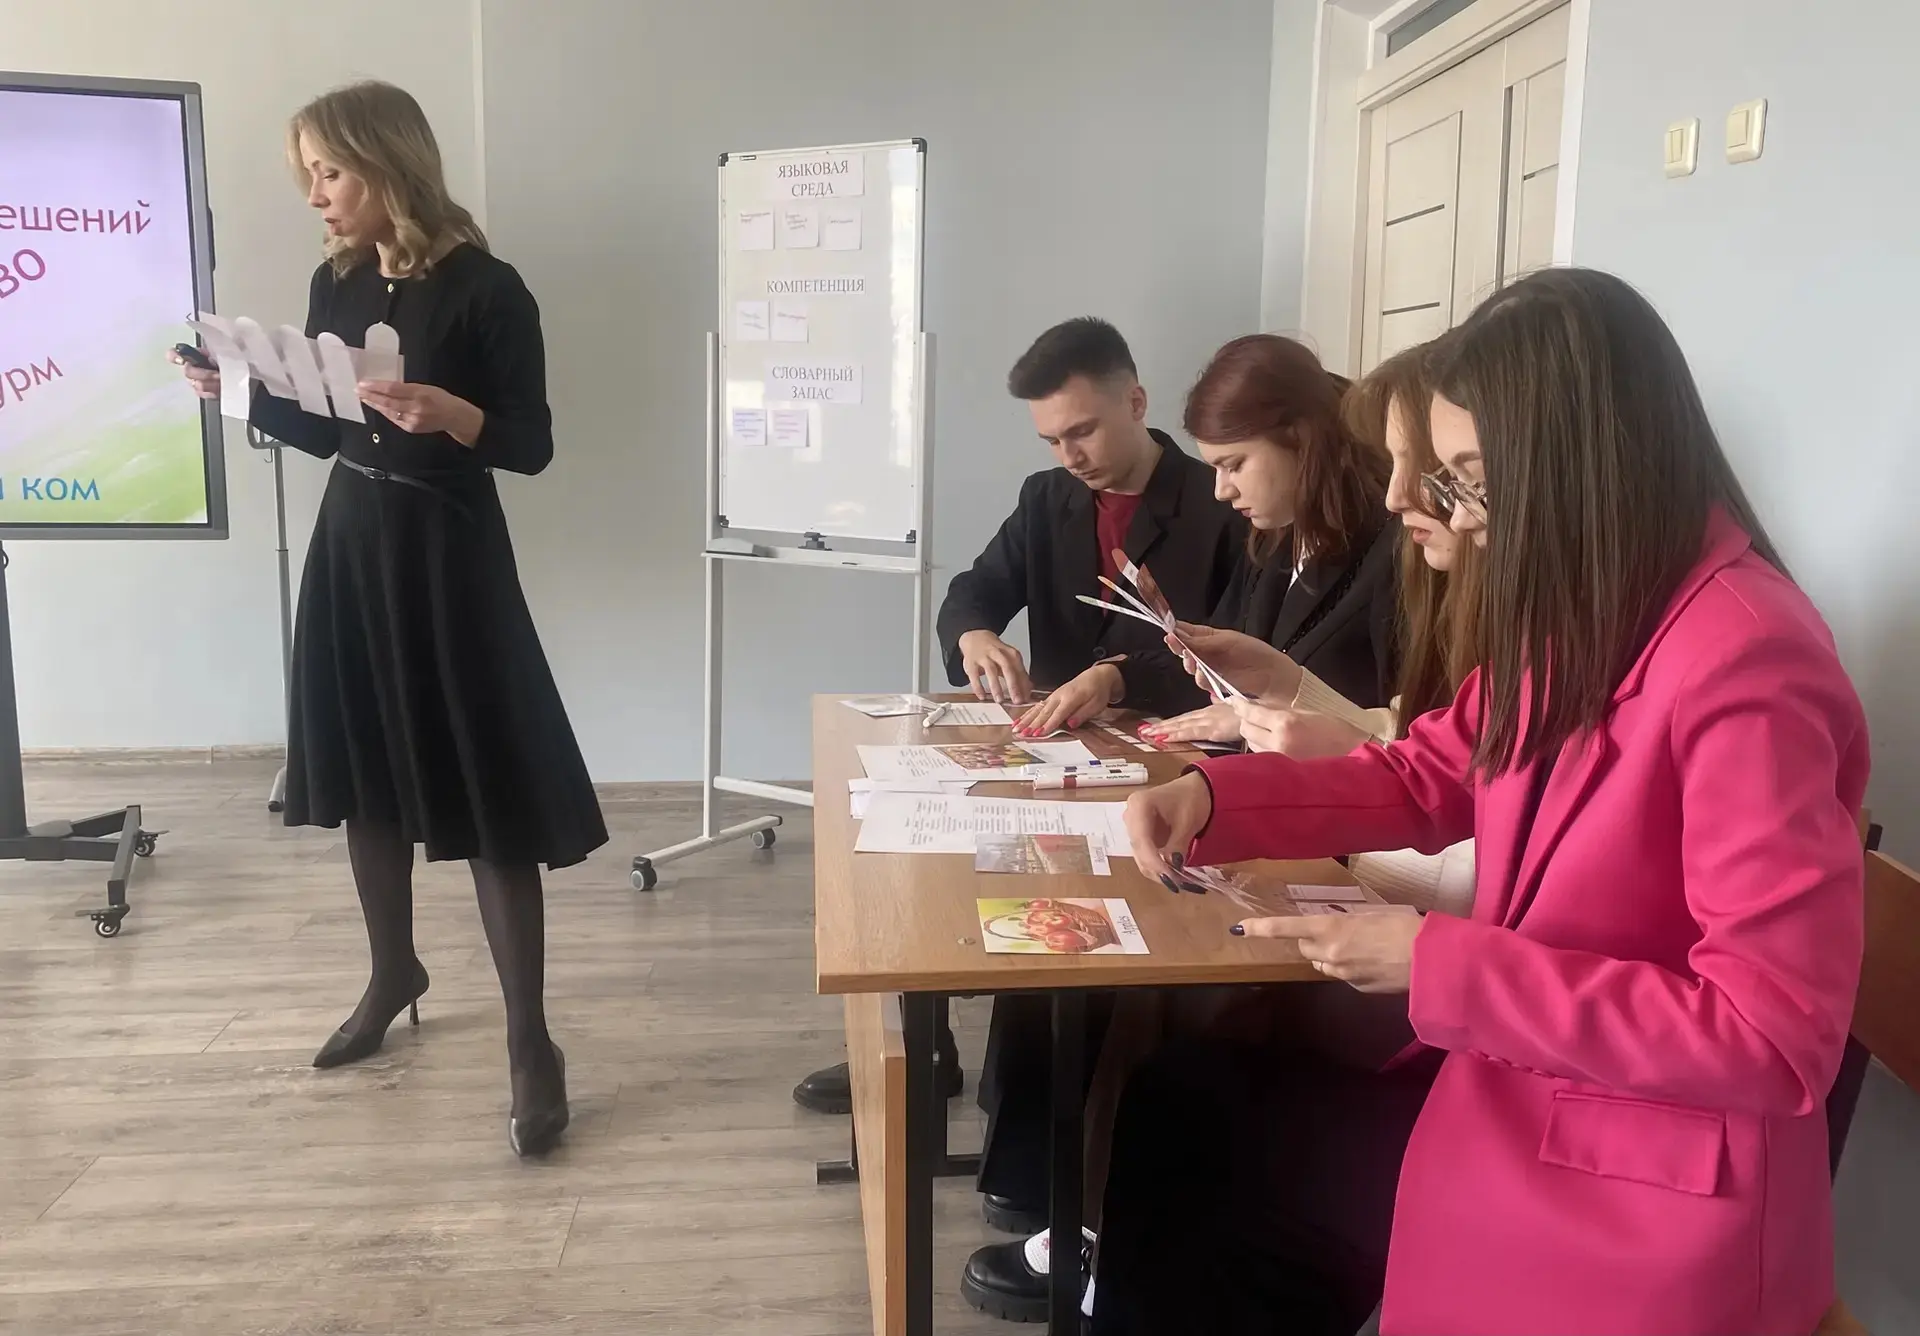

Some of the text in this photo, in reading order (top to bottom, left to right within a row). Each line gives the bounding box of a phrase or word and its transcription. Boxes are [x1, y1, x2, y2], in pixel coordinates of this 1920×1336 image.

[777, 160, 849, 179] ЯЗЫКОВАЯ
[791, 182, 834, 198] СРЕДА
[766, 278, 865, 294] КОМПЕТЕНЦИЯ
[772, 365, 853, 382] СЛОВАРНЫЙ
[791, 386, 834, 401] ЗАПАС
[22, 477, 101, 501] ком
